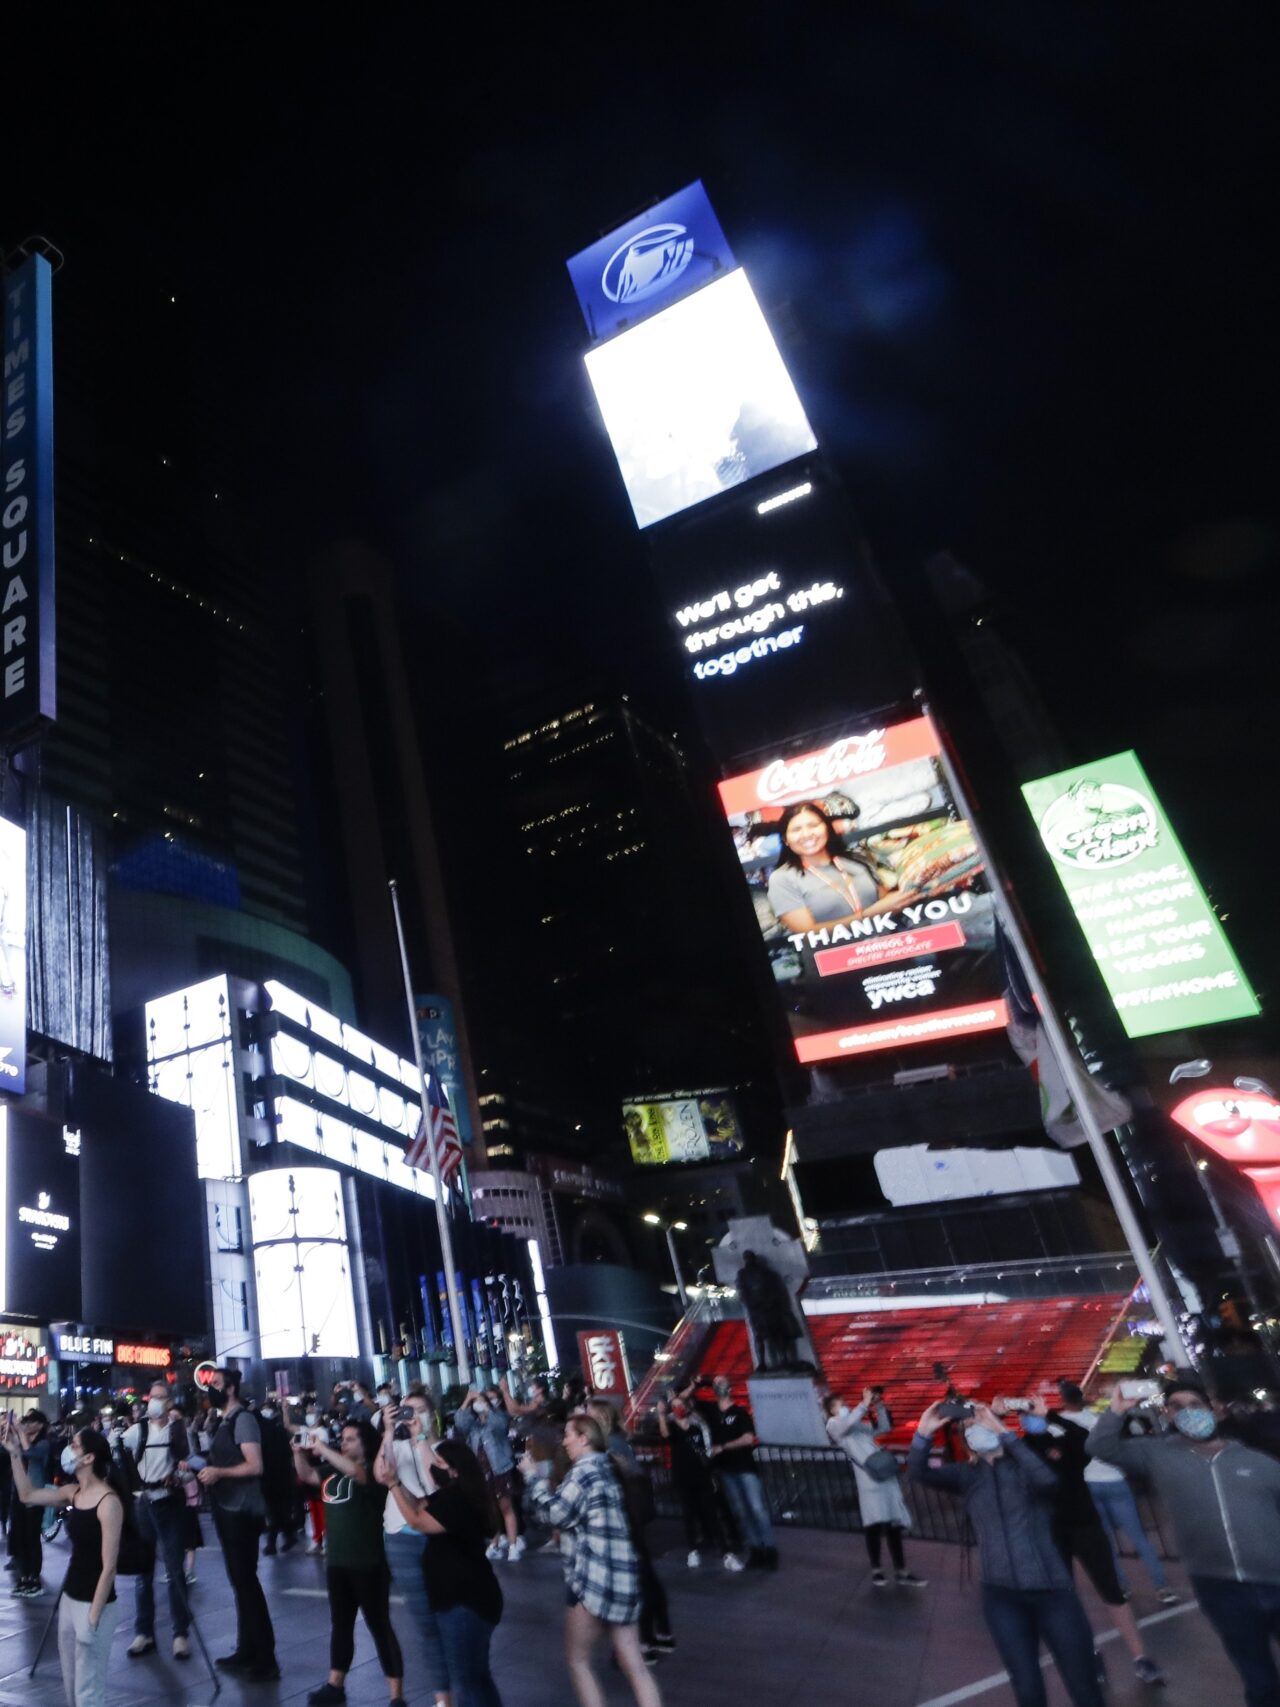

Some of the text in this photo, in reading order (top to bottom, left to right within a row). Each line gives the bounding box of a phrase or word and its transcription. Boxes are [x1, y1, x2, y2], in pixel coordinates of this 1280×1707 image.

[4, 281, 29, 440] TIMES
[2, 458, 29, 699] SQUARE
[734, 572, 780, 608] get
[685, 603, 785, 652] through
[693, 625, 804, 679] together
[756, 728, 886, 803] Coca-Cola
[1058, 811, 1153, 851] Green
[1077, 826, 1160, 864] Giant
[787, 891, 972, 953] THANK YOU
[867, 979, 936, 1009] ywca
[61, 1335, 113, 1355] BLUE FIN
[587, 1335, 616, 1390] tkts
